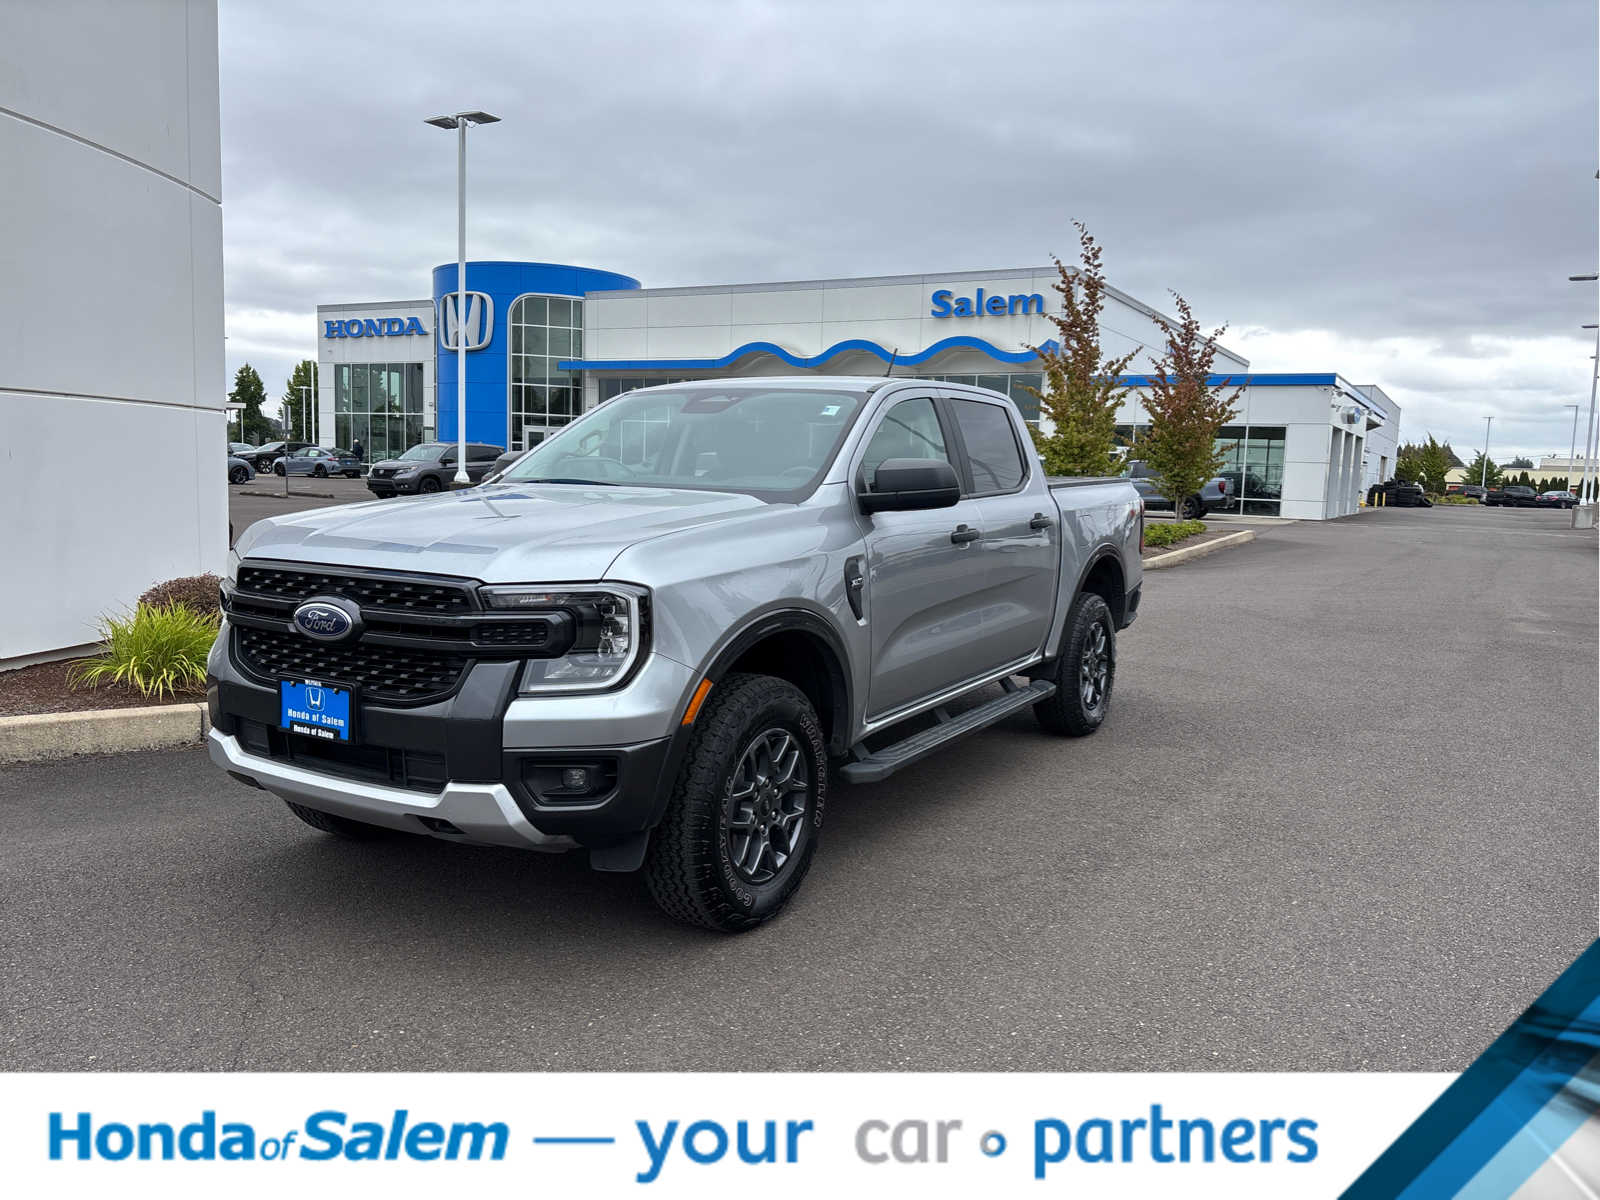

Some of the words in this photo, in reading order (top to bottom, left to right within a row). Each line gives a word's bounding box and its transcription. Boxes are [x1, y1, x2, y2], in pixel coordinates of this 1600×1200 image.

[931, 288, 1043, 317] Salem
[325, 317, 425, 337] HONDA
[305, 610, 336, 631] Ford
[287, 708, 310, 721] Honda
[312, 713, 319, 722] of
[321, 714, 345, 727] Salem
[293, 724, 310, 735] Honda
[317, 729, 334, 740] Salem
